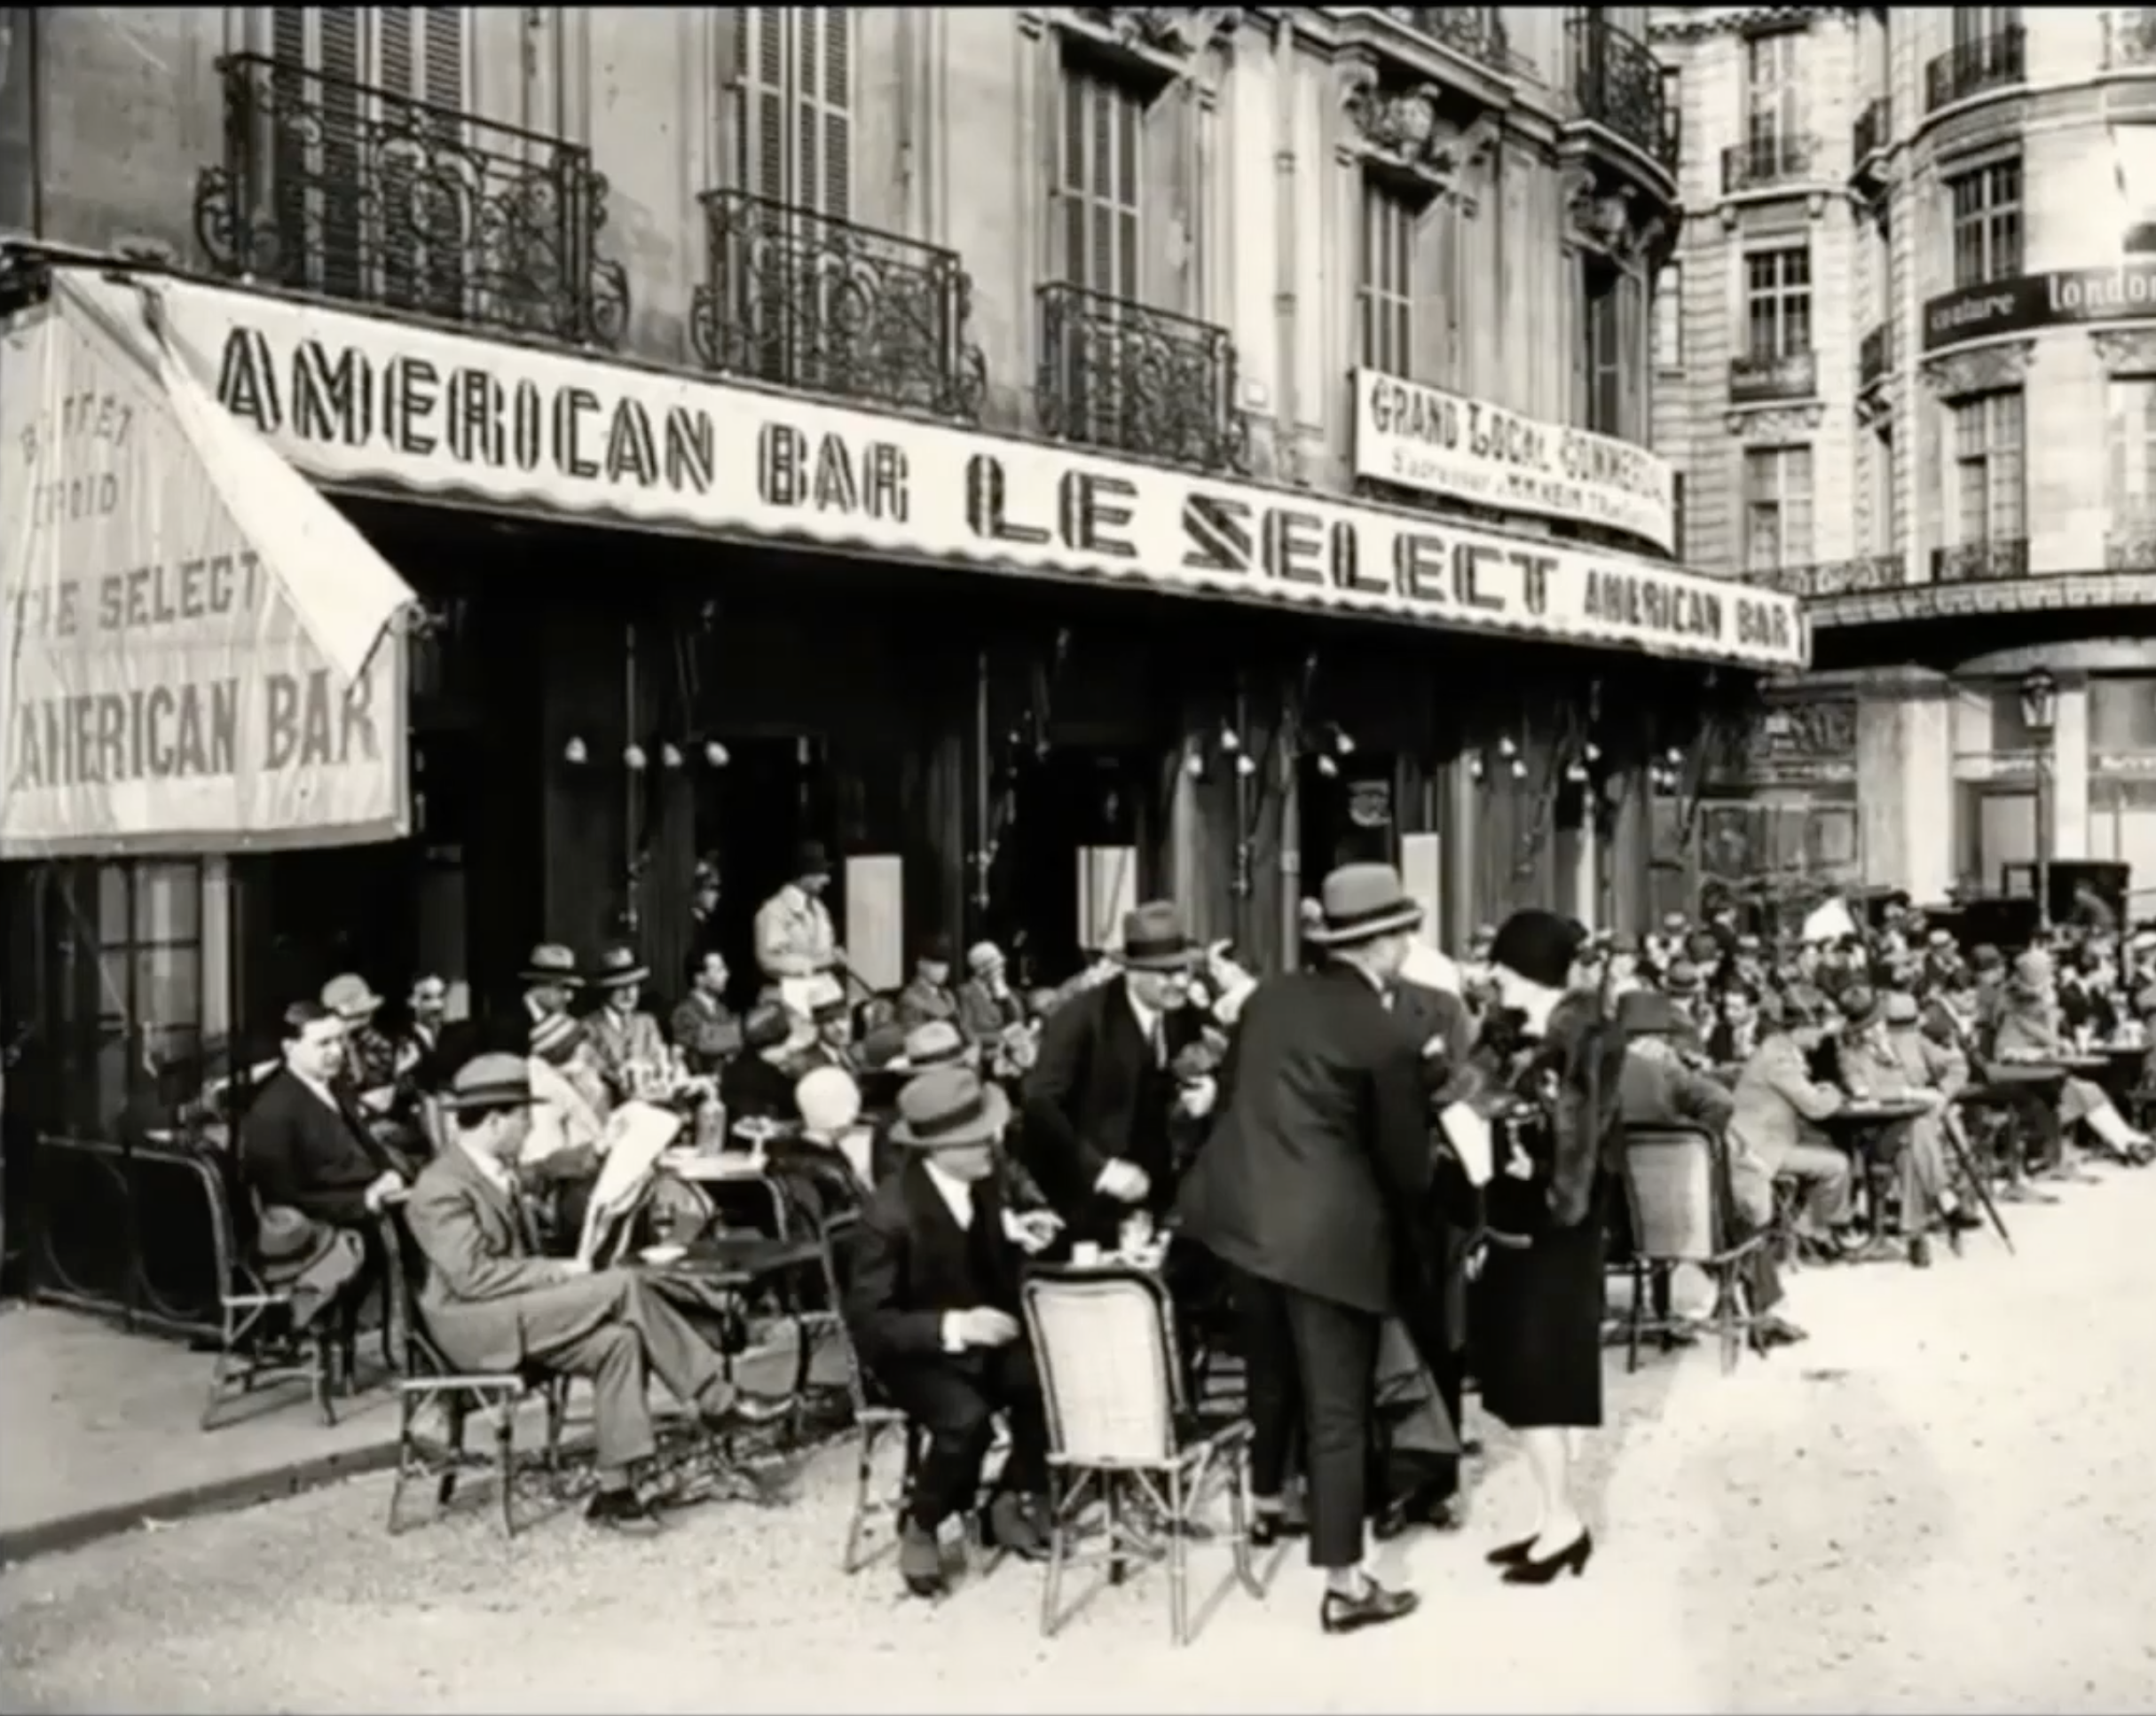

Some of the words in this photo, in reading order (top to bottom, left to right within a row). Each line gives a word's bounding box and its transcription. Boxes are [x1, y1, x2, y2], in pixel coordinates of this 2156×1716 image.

[1371, 377, 1458, 450] GRAND
[216, 325, 714, 494] AMERICAN
[757, 421, 909, 523] BAR
[965, 453, 1138, 557] LE
[1181, 492, 1559, 617] SELECT
[1584, 568, 1723, 642] AMERICAN
[1736, 597, 1790, 649] BAR
[98, 548, 261, 631] SELECT
[9, 678, 238, 791] AMERICAN
[266, 670, 380, 770] BAR
